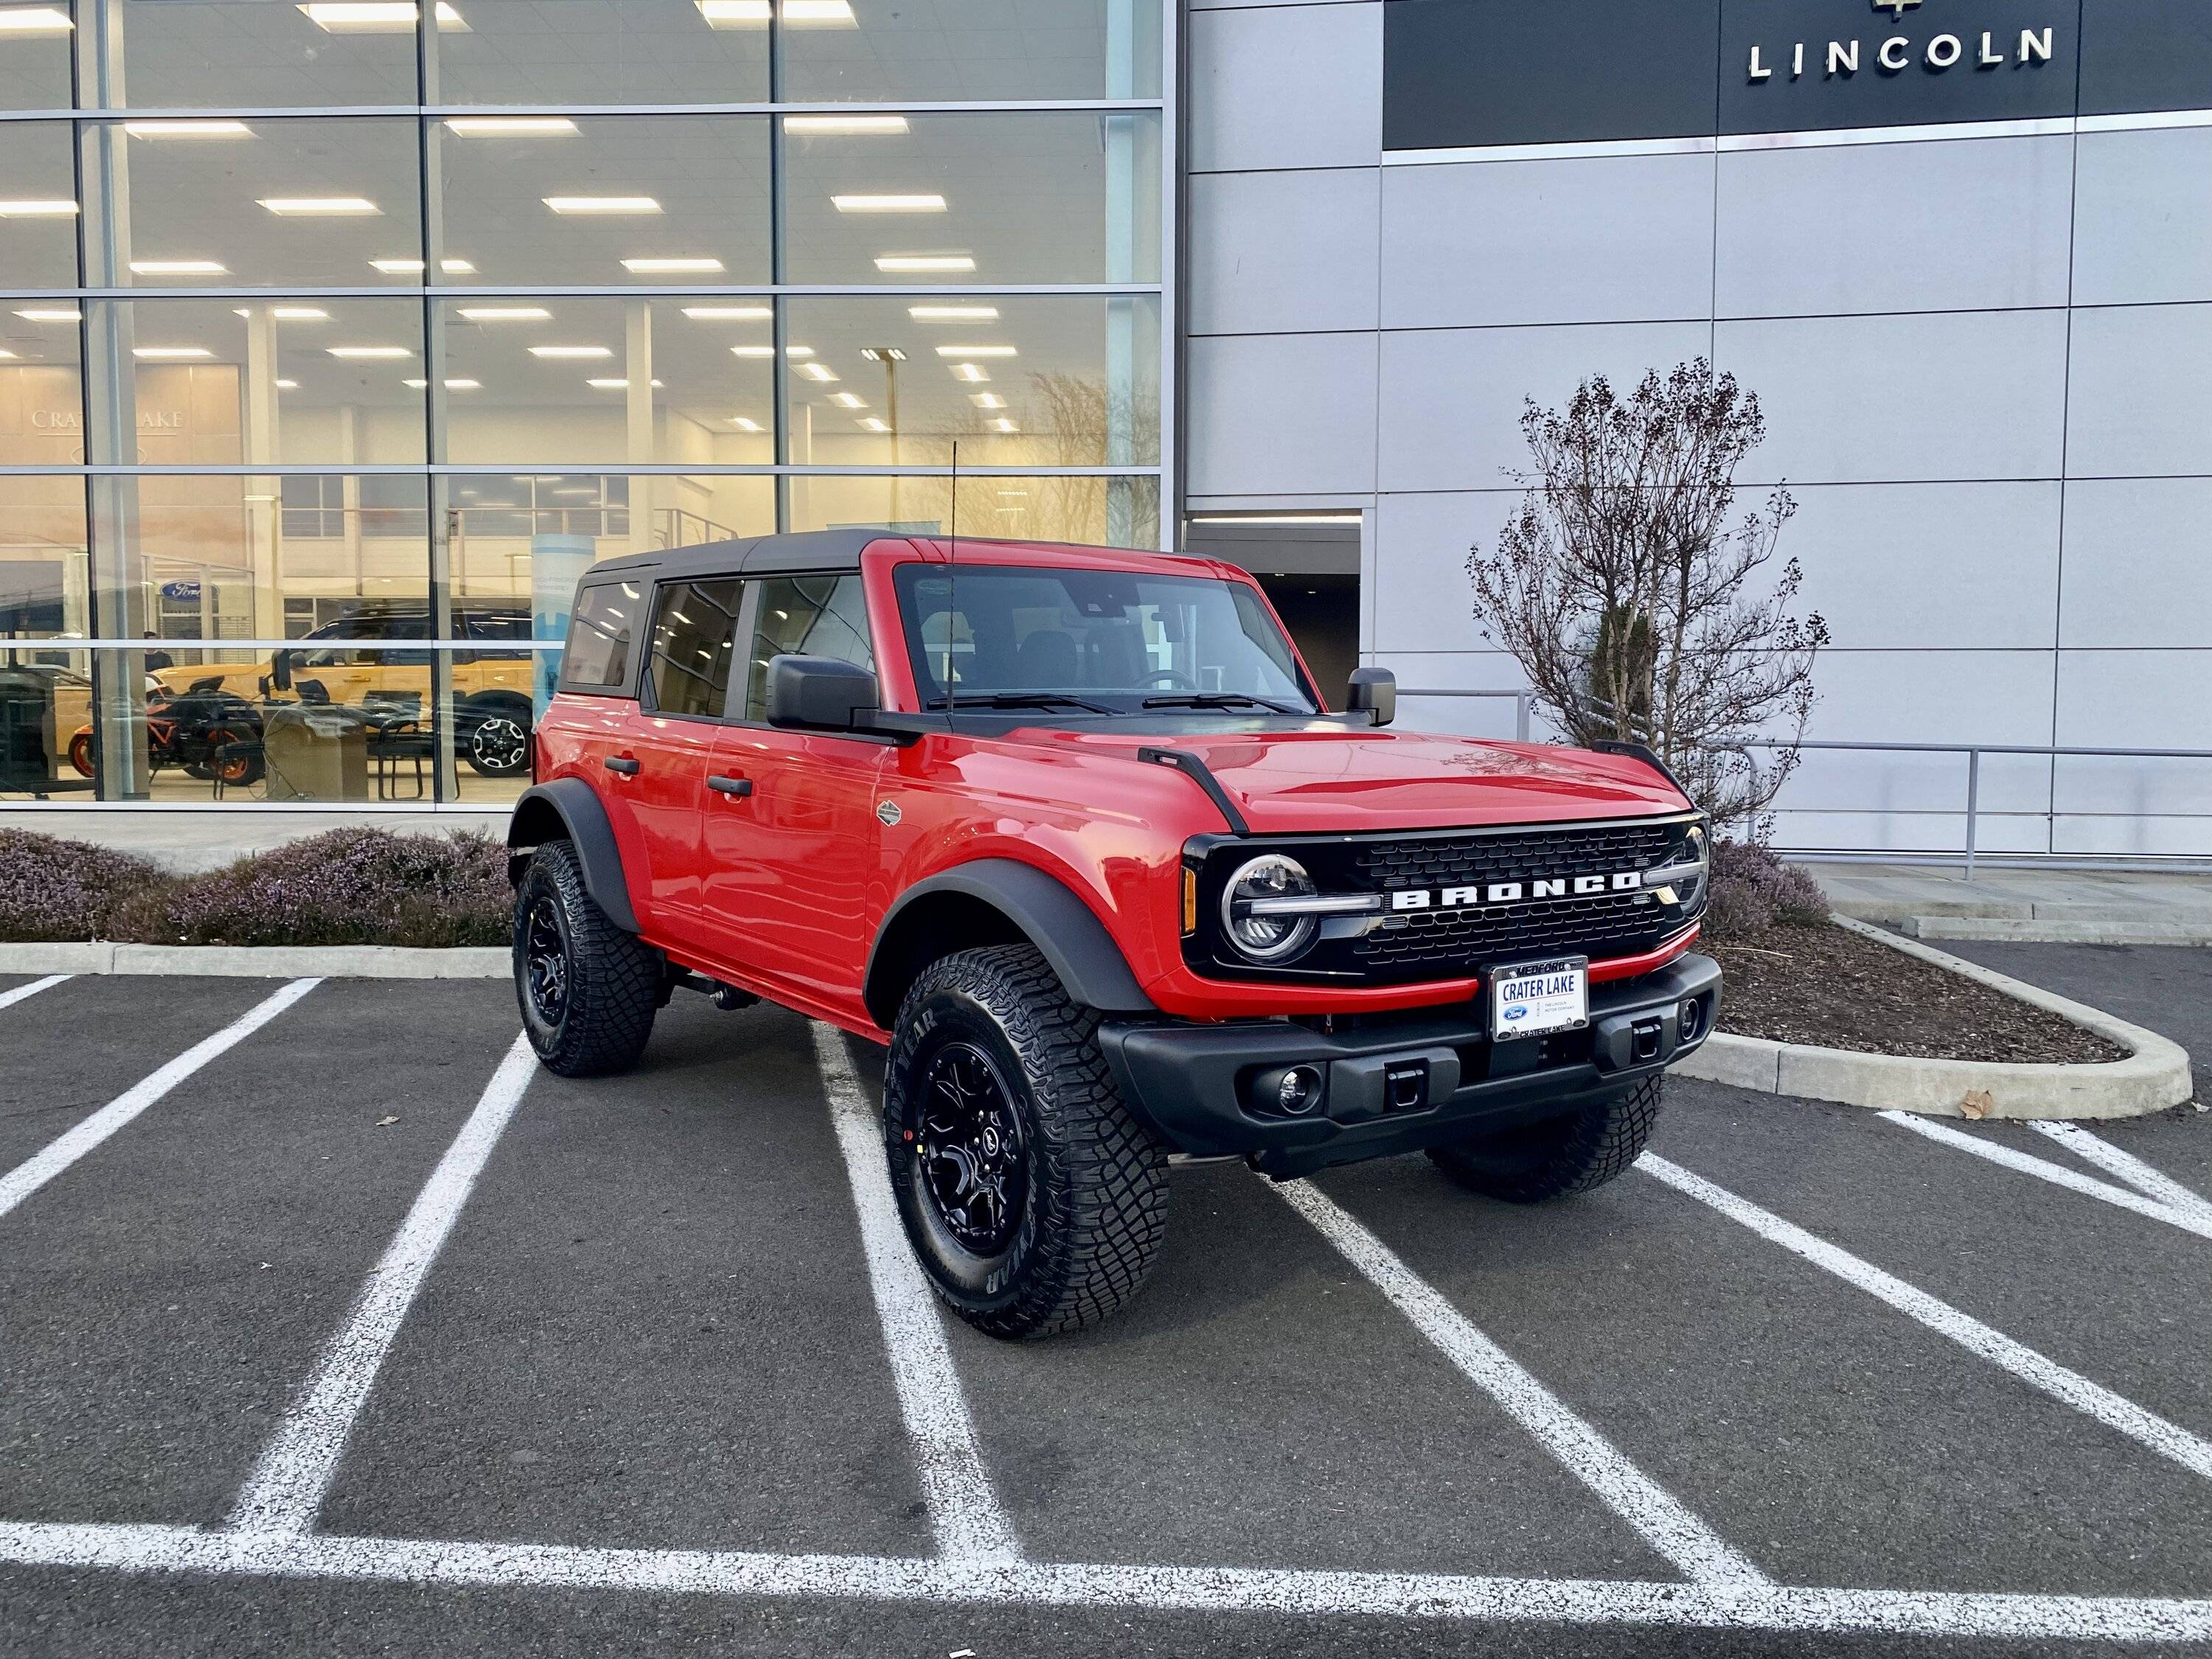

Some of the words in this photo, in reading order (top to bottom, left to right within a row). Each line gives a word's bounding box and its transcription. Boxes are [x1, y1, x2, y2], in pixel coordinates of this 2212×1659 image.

[1750, 27, 2053, 78] LINCOLN
[136, 411, 183, 428] AKE
[1392, 872, 1641, 909] BRONCO
[1517, 961, 1565, 976] MEDFORD
[1503, 979, 1544, 1001] CRATER
[1547, 975, 1574, 995] LAKE
[1520, 1027, 1546, 1038] CRATER
[1548, 1024, 1565, 1034] LAKE
